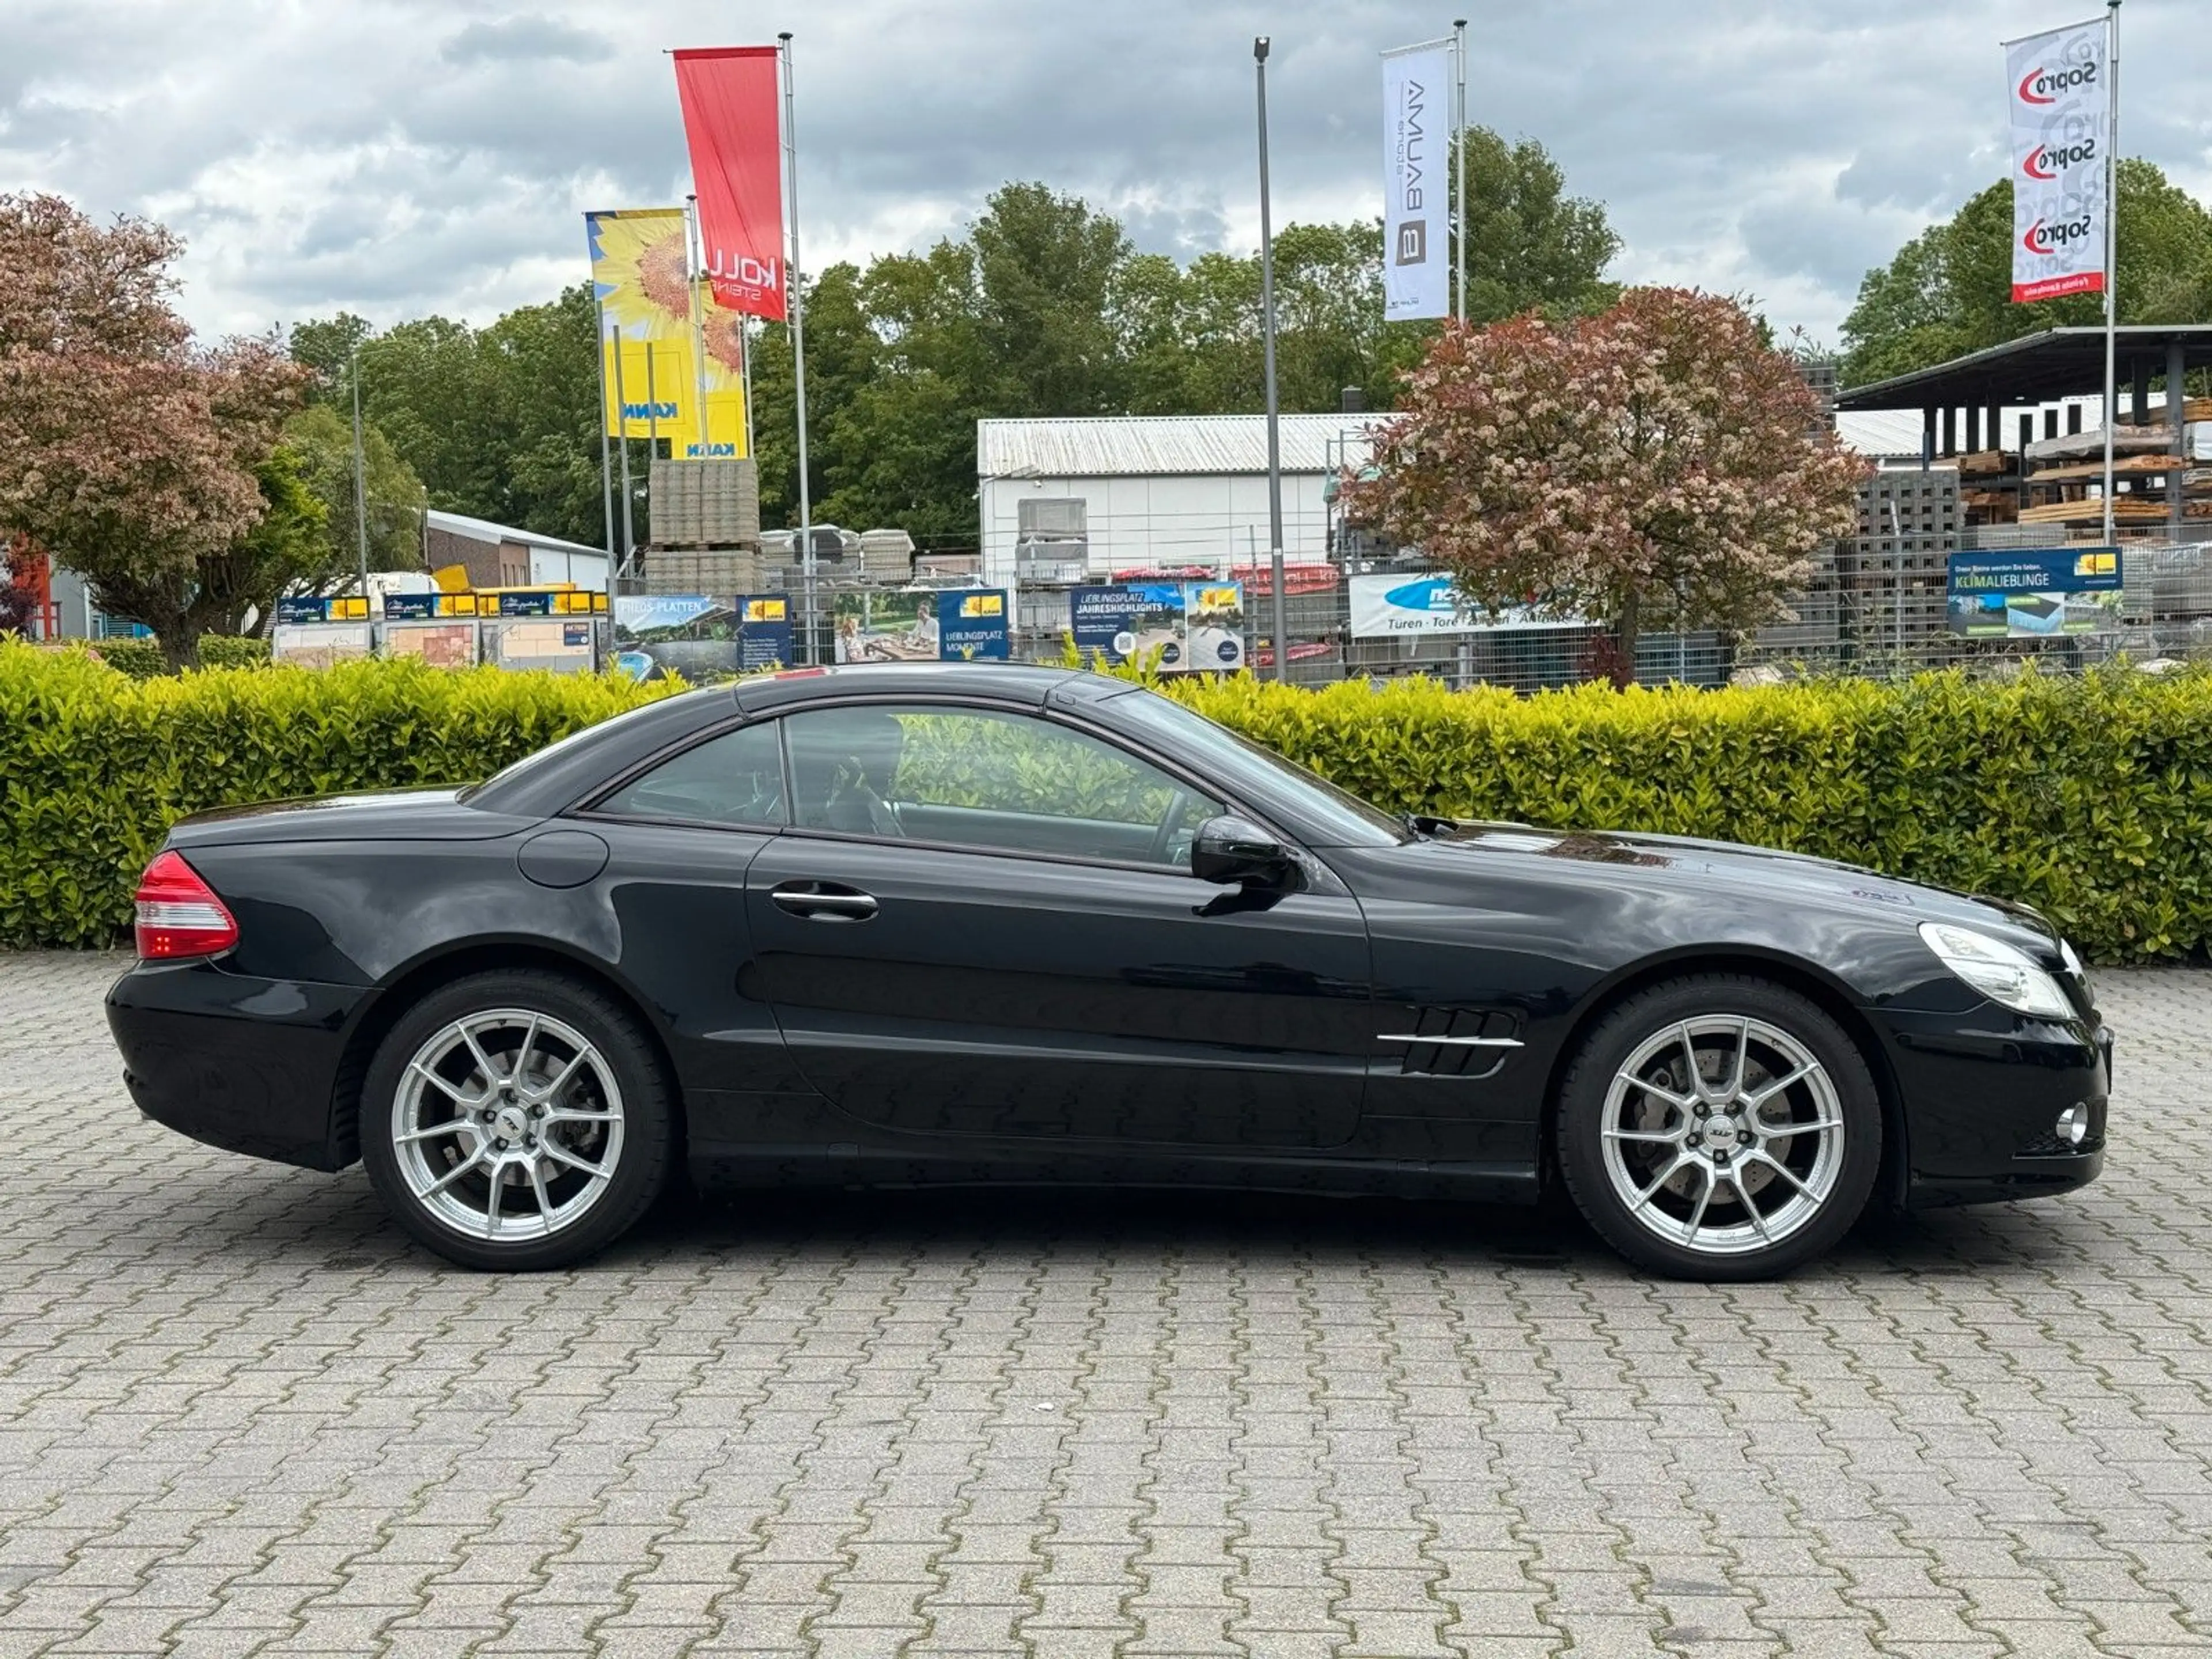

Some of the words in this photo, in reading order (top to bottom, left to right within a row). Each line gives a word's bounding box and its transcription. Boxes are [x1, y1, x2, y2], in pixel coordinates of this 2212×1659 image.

[1955, 573, 2050, 589] KLIMALIEBLINGE
[1081, 593, 1144, 604] LIEBLINGSPLATZ
[1076, 603, 1163, 614] JAHRESHIGHLIGHTS
